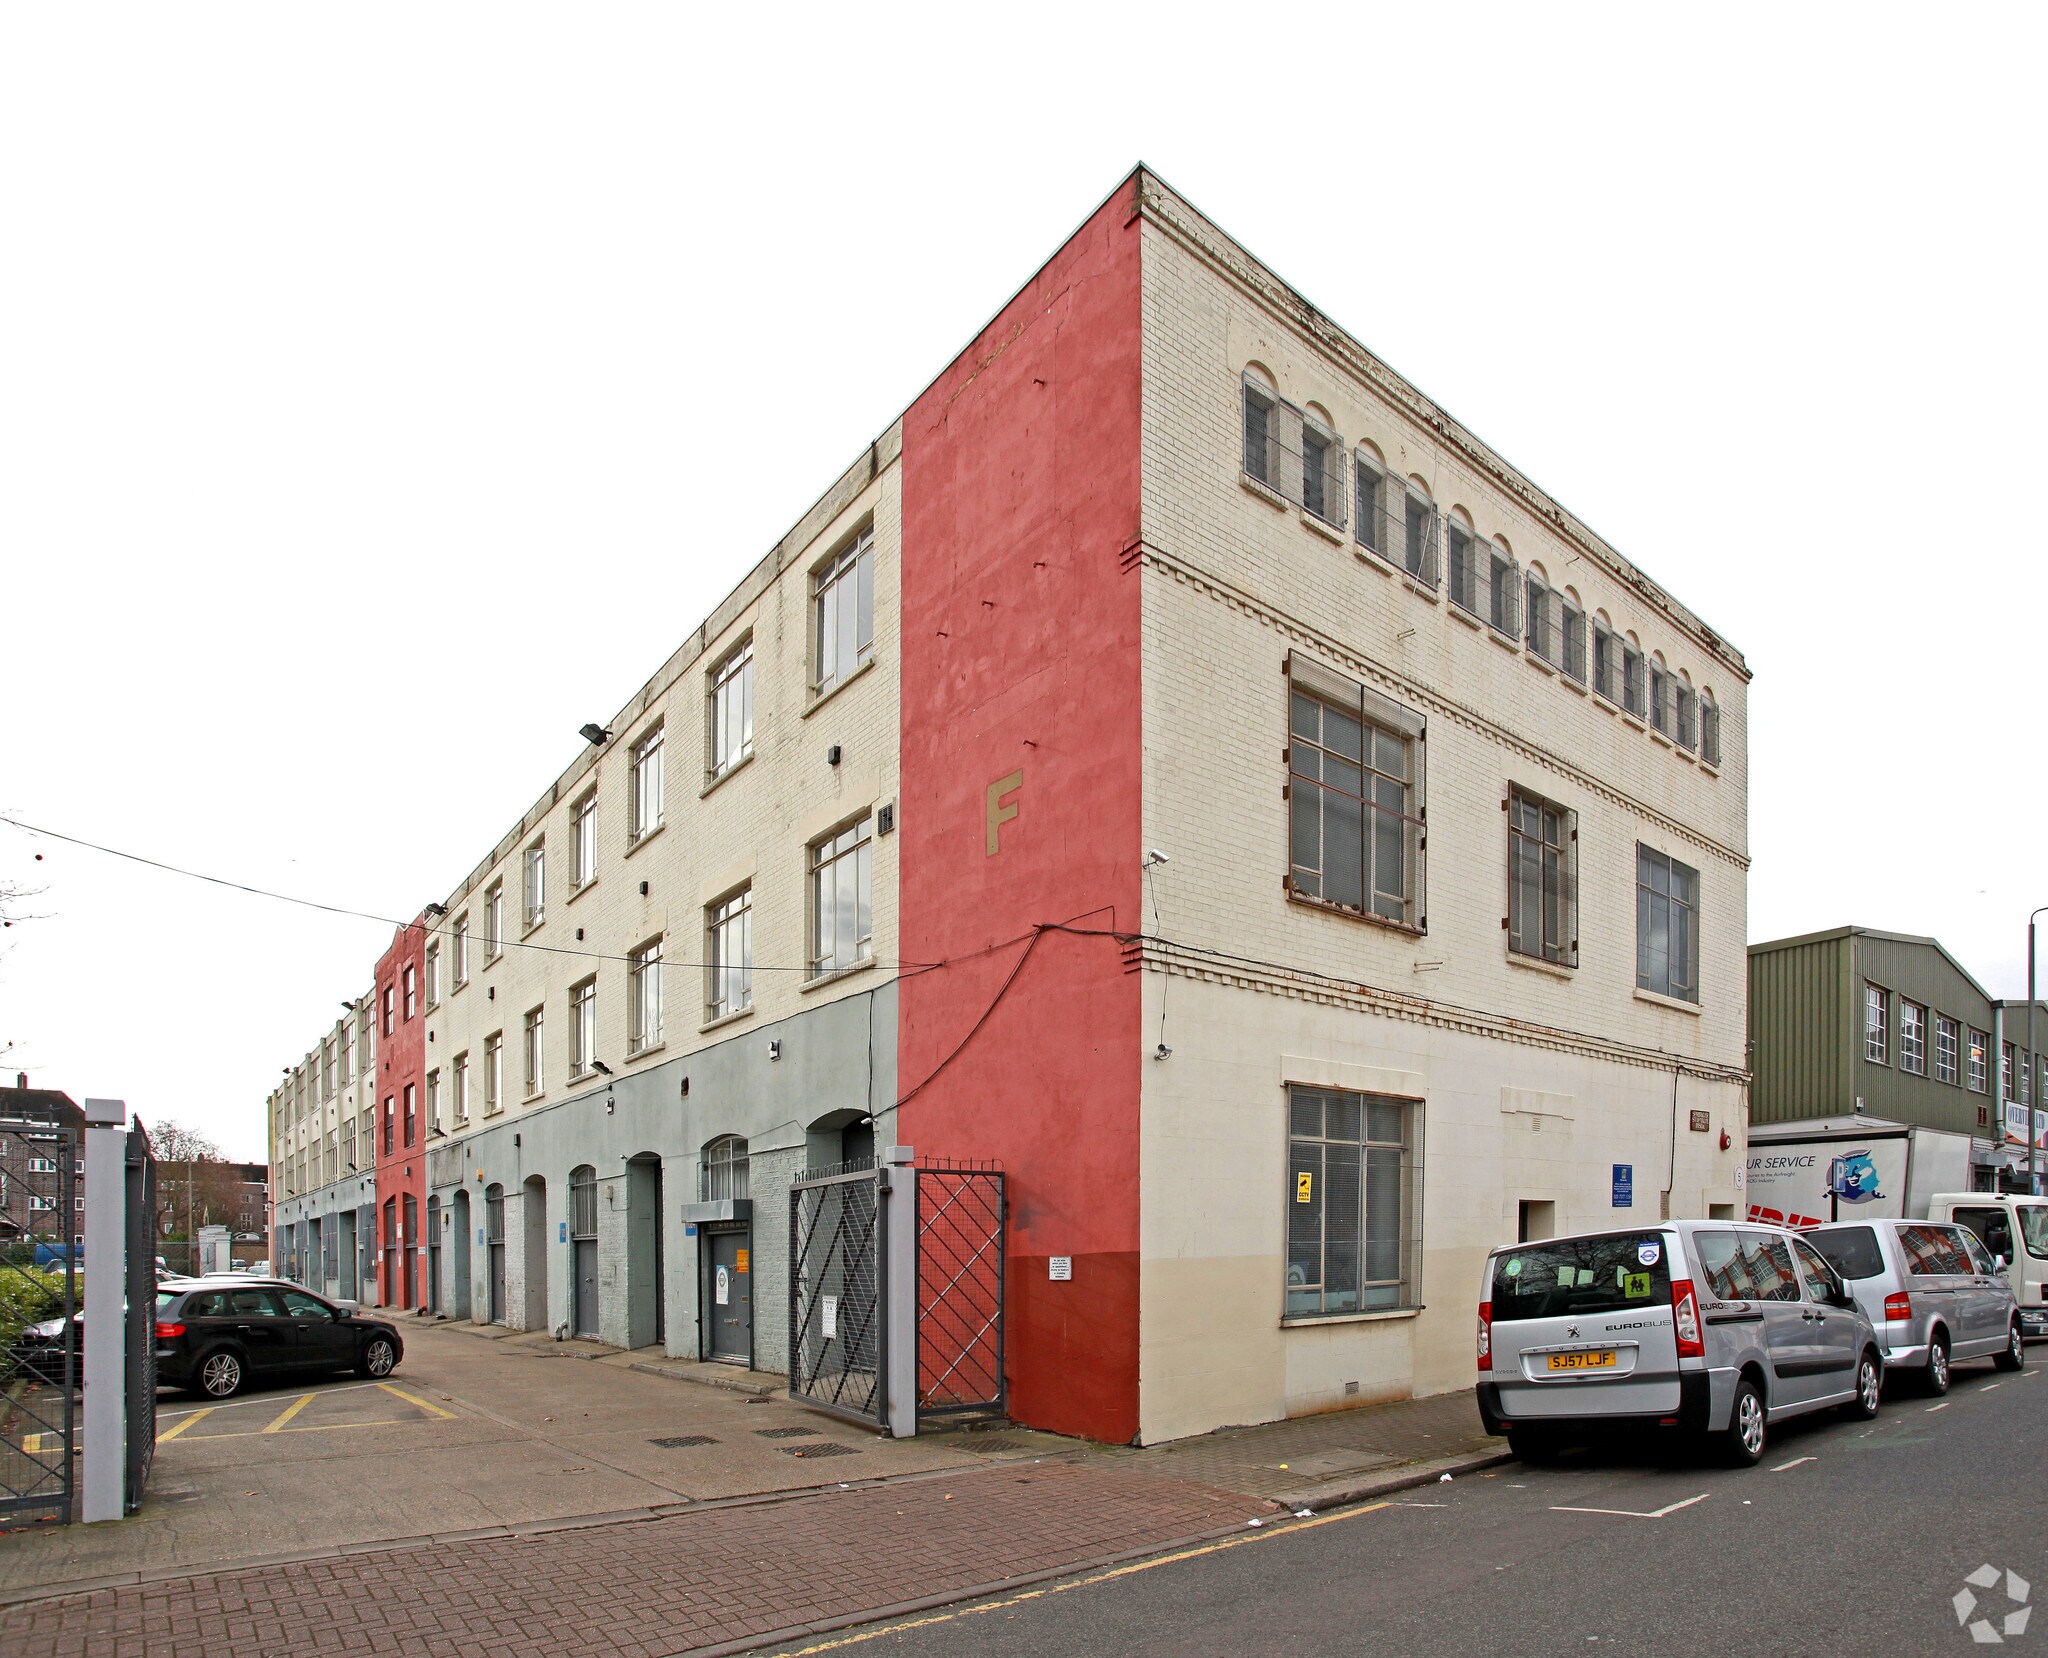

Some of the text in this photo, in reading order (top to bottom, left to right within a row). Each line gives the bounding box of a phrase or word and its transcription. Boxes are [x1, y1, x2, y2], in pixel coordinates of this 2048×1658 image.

[986, 768, 1023, 858] F
[1764, 1156, 1816, 1169] SERVICE
[1838, 1161, 1845, 1190] P
[1700, 1302, 1739, 1310] EUROBUS
[1605, 1320, 1672, 1331] EUROBUS
[1553, 1353, 1611, 1368] SJ57 LJF
